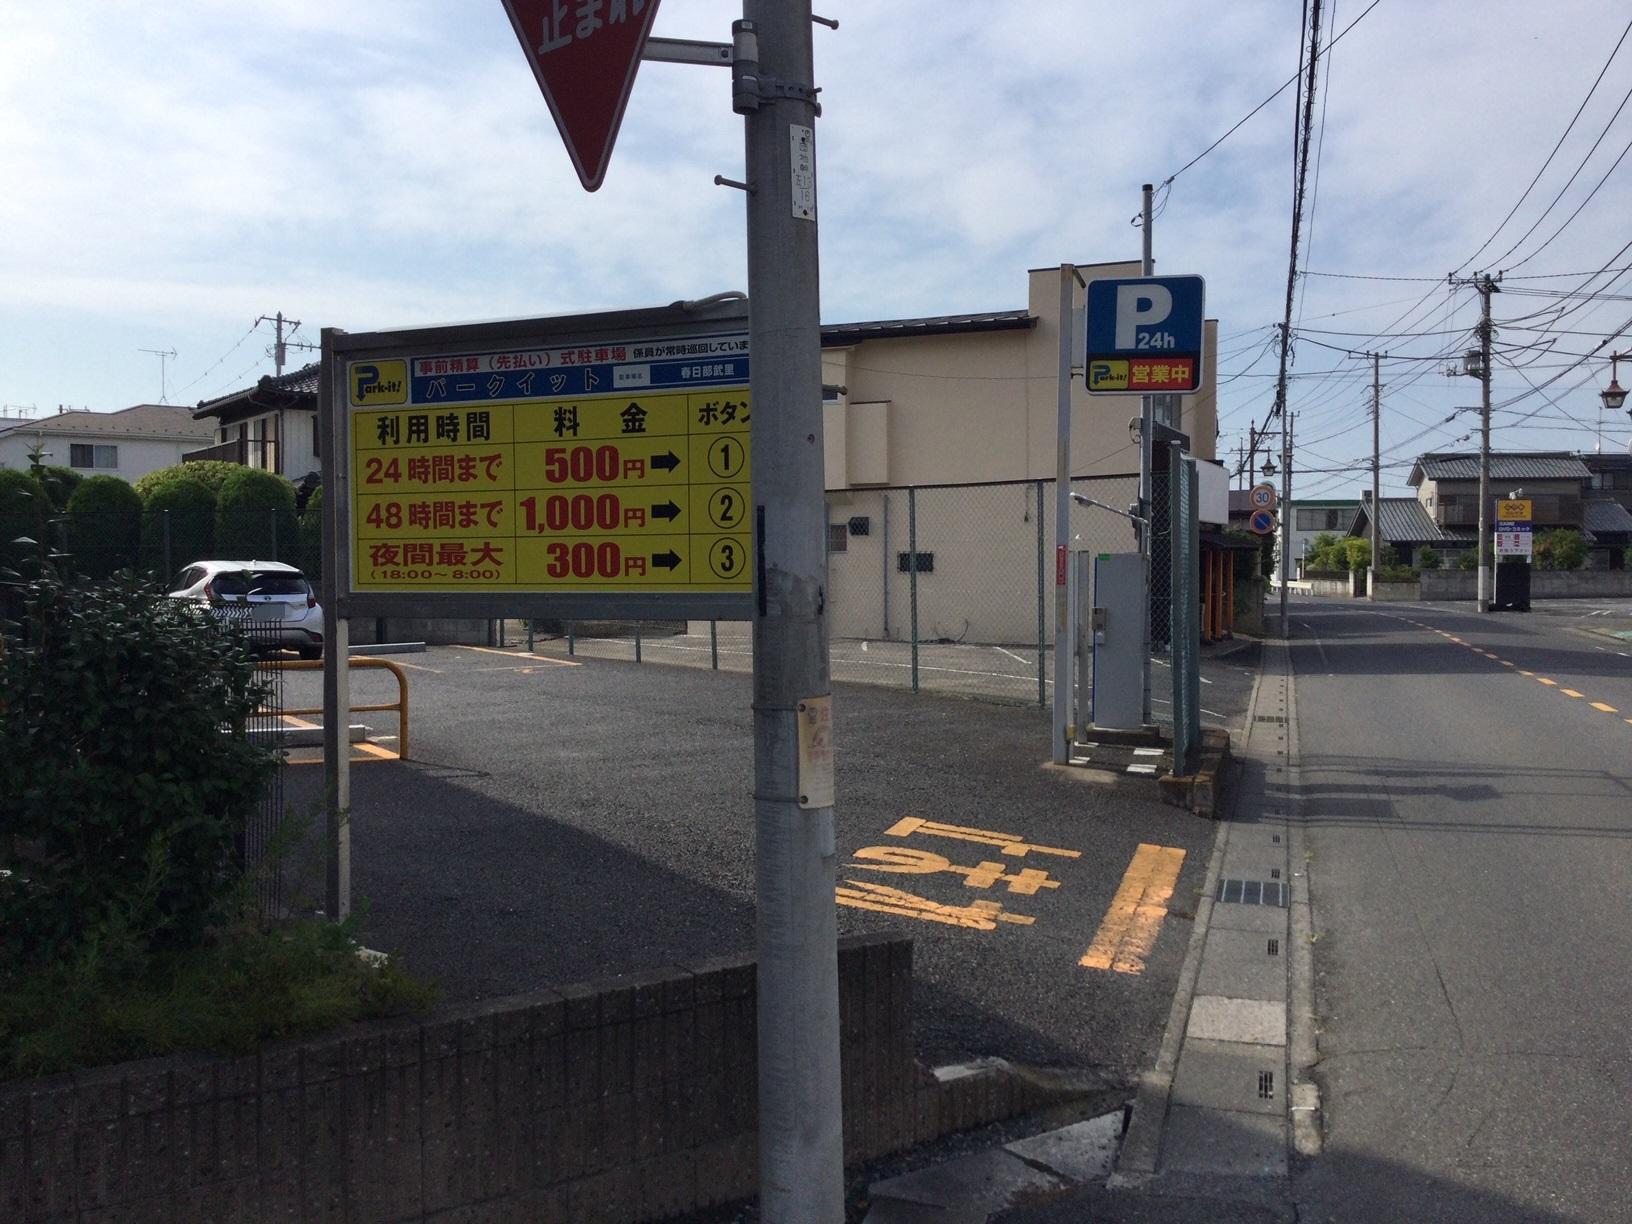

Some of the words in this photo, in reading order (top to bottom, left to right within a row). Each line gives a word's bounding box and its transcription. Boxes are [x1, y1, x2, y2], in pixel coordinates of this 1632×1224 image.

[1114, 284, 1174, 350] P
[1137, 332, 1176, 349] 24h
[680, 363, 735, 379] 春日部武里
[1132, 364, 1189, 384] 営業中
[698, 401, 751, 427] ボタン
[377, 411, 491, 445] 利用時間
[544, 444, 646, 484] 500円
[1255, 492, 1270, 503] 30
[519, 493, 647, 534] 1,000円
[369, 542, 504, 567] 夜間最大
[546, 541, 647, 578] 300円
